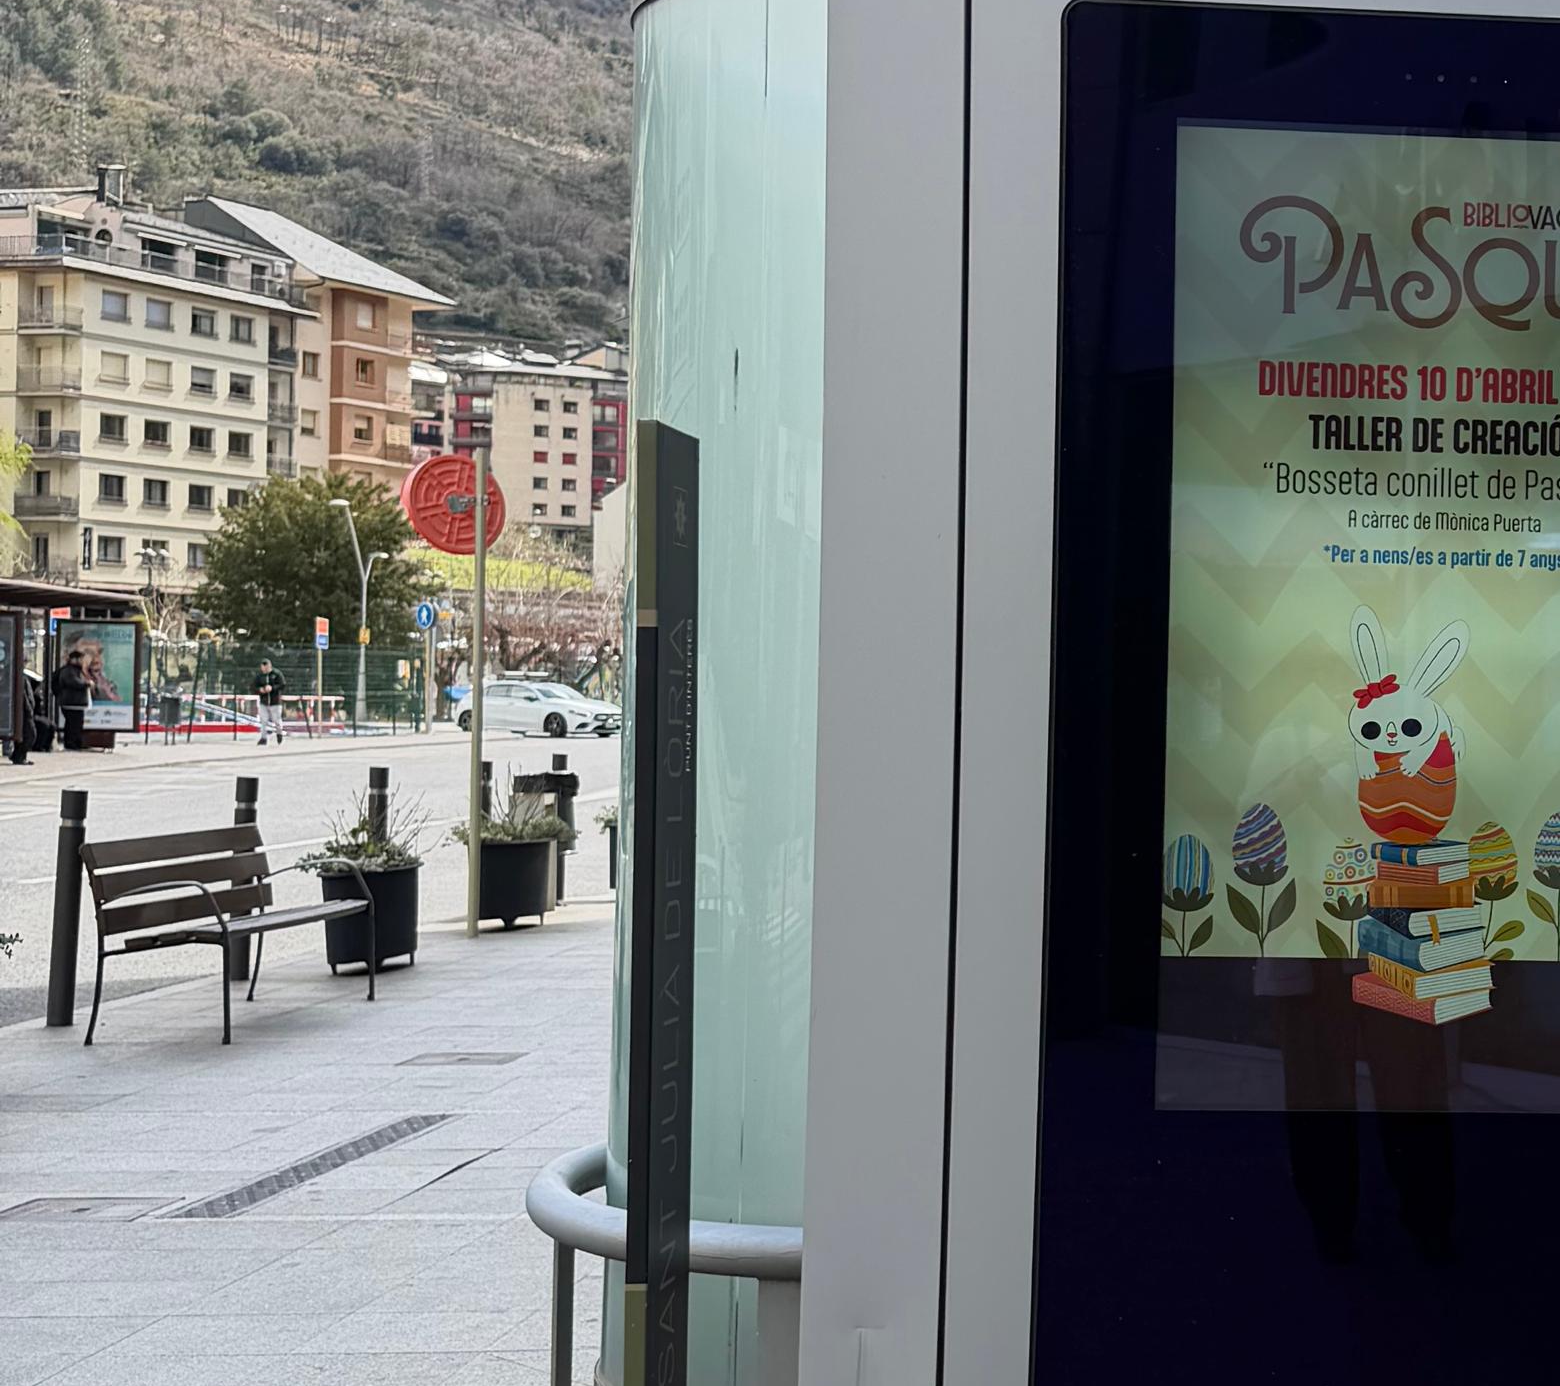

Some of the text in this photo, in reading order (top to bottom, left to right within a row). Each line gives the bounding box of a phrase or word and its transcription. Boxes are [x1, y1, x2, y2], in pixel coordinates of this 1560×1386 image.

[1259, 361, 1407, 400] DIVENDRES
[1417, 366, 1446, 401] 10
[1456, 368, 1559, 405] D'ABRIL
[1309, 414, 1402, 452] TALLER
[1412, 418, 1444, 453] DE
[1264, 462, 1377, 495] “Bosseta
[1387, 467, 1480, 498] conillet
[1488, 469, 1516, 499] de
[1348, 509, 1541, 532] A càrrec de Mònica Puerta
[1360, 549, 1368, 563] a
[1373, 546, 1433, 565] nens/es
[1438, 552, 1446, 565] a
[1451, 549, 1491, 568] partir
[1496, 549, 1513, 567] de
[1518, 550, 1525, 567] 7
[663, 618, 688, 823] LÒRIA
[685, 724, 693, 773] PUNT
[664, 848, 682, 941] DE
[659, 963, 681, 1174] JULIÀ
